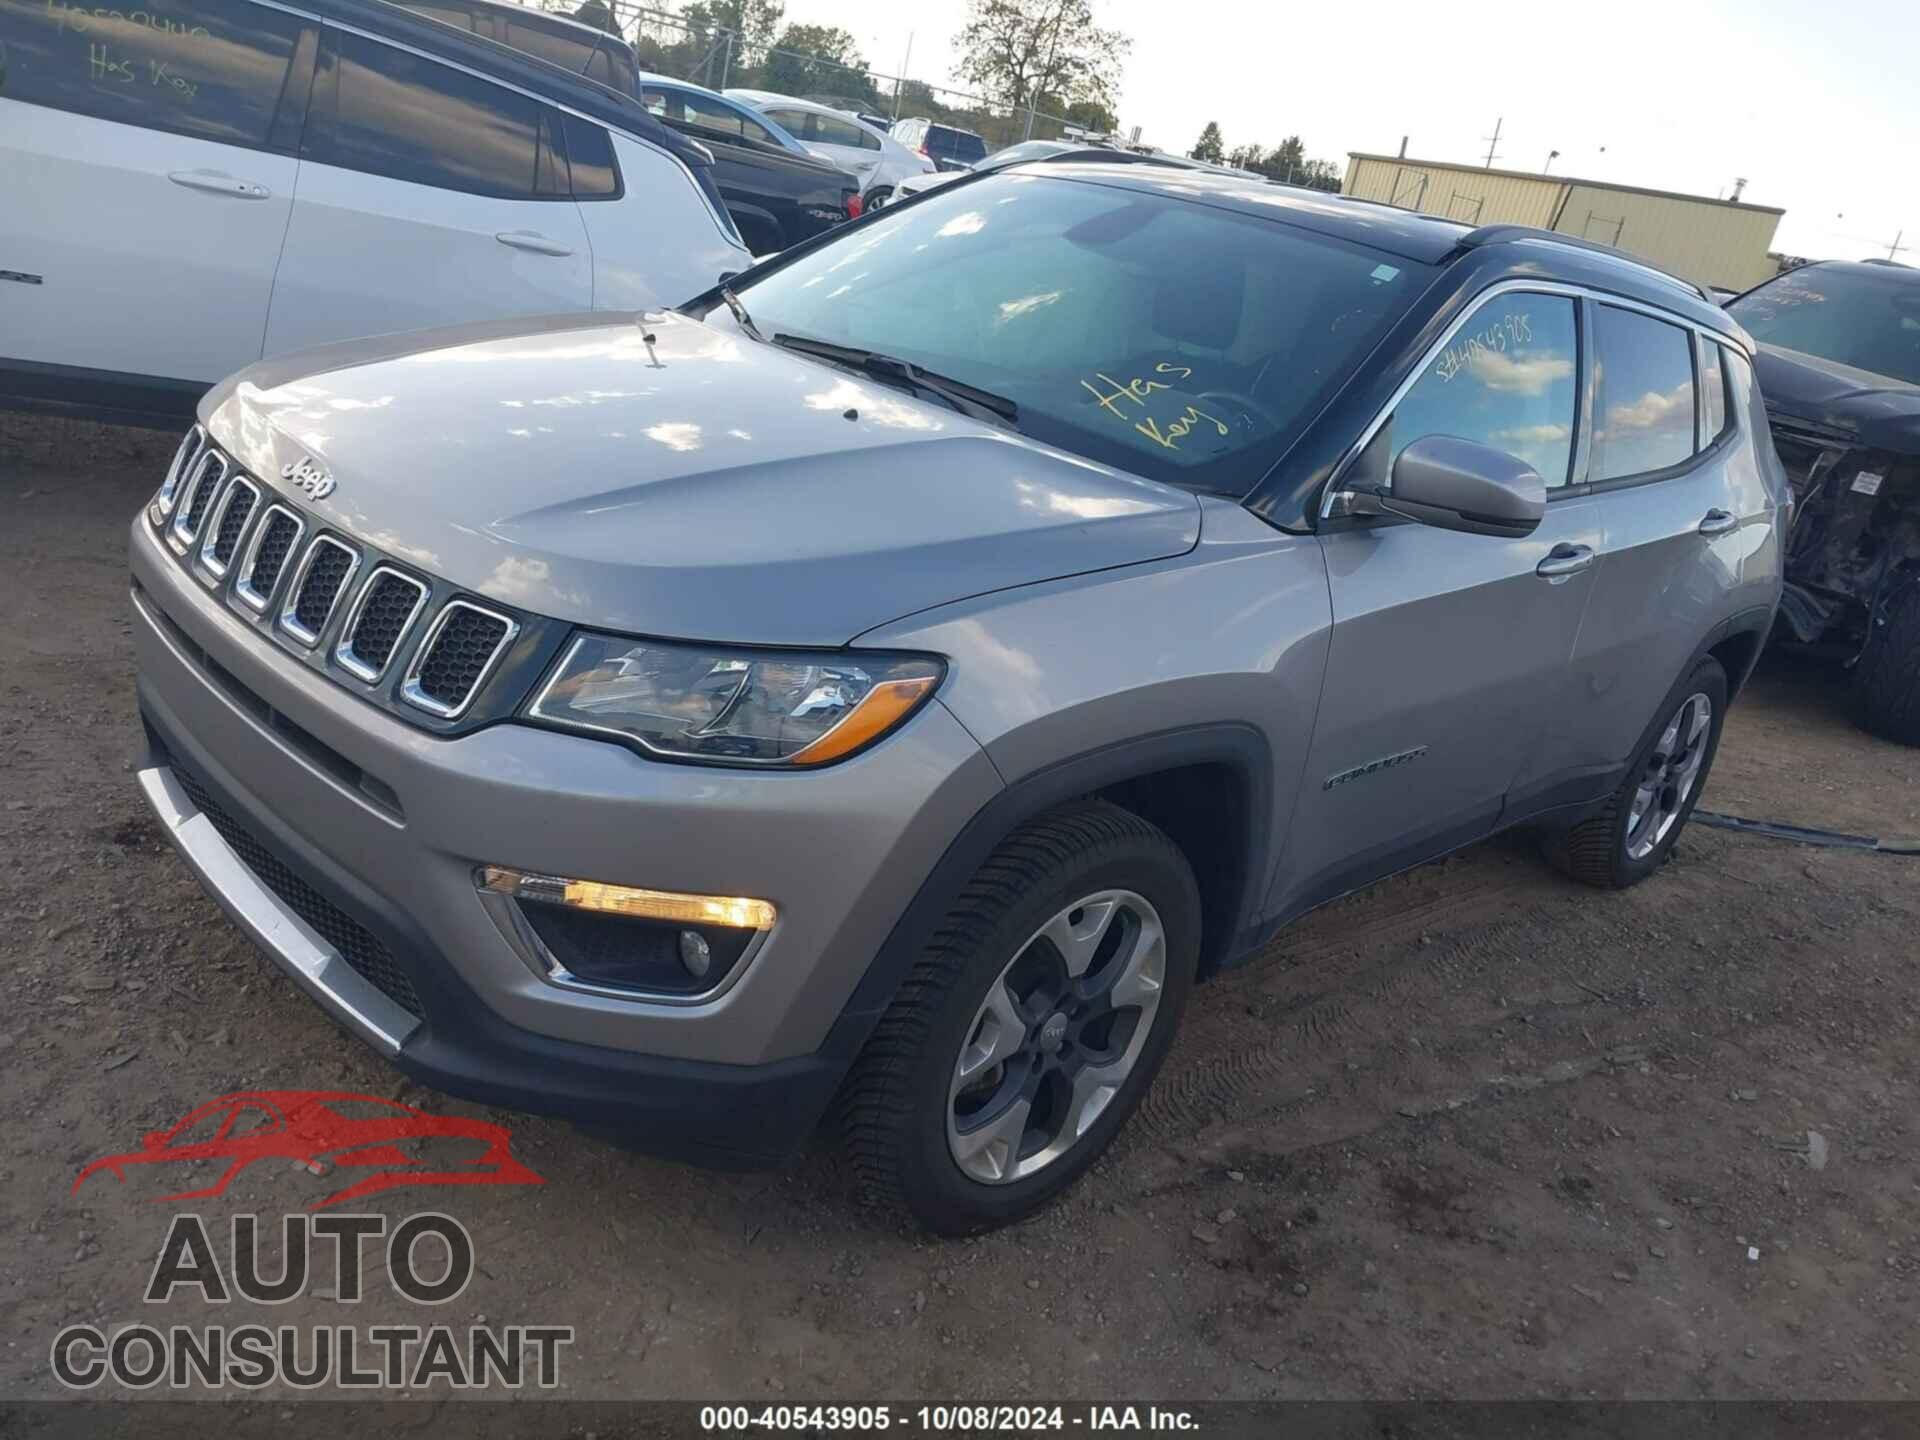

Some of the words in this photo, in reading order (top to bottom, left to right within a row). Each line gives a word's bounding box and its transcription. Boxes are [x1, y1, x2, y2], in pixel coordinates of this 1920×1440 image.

[1081, 362, 1191, 420] Has
[1135, 406, 1229, 450] Key
[281, 456, 334, 500] Jeep
